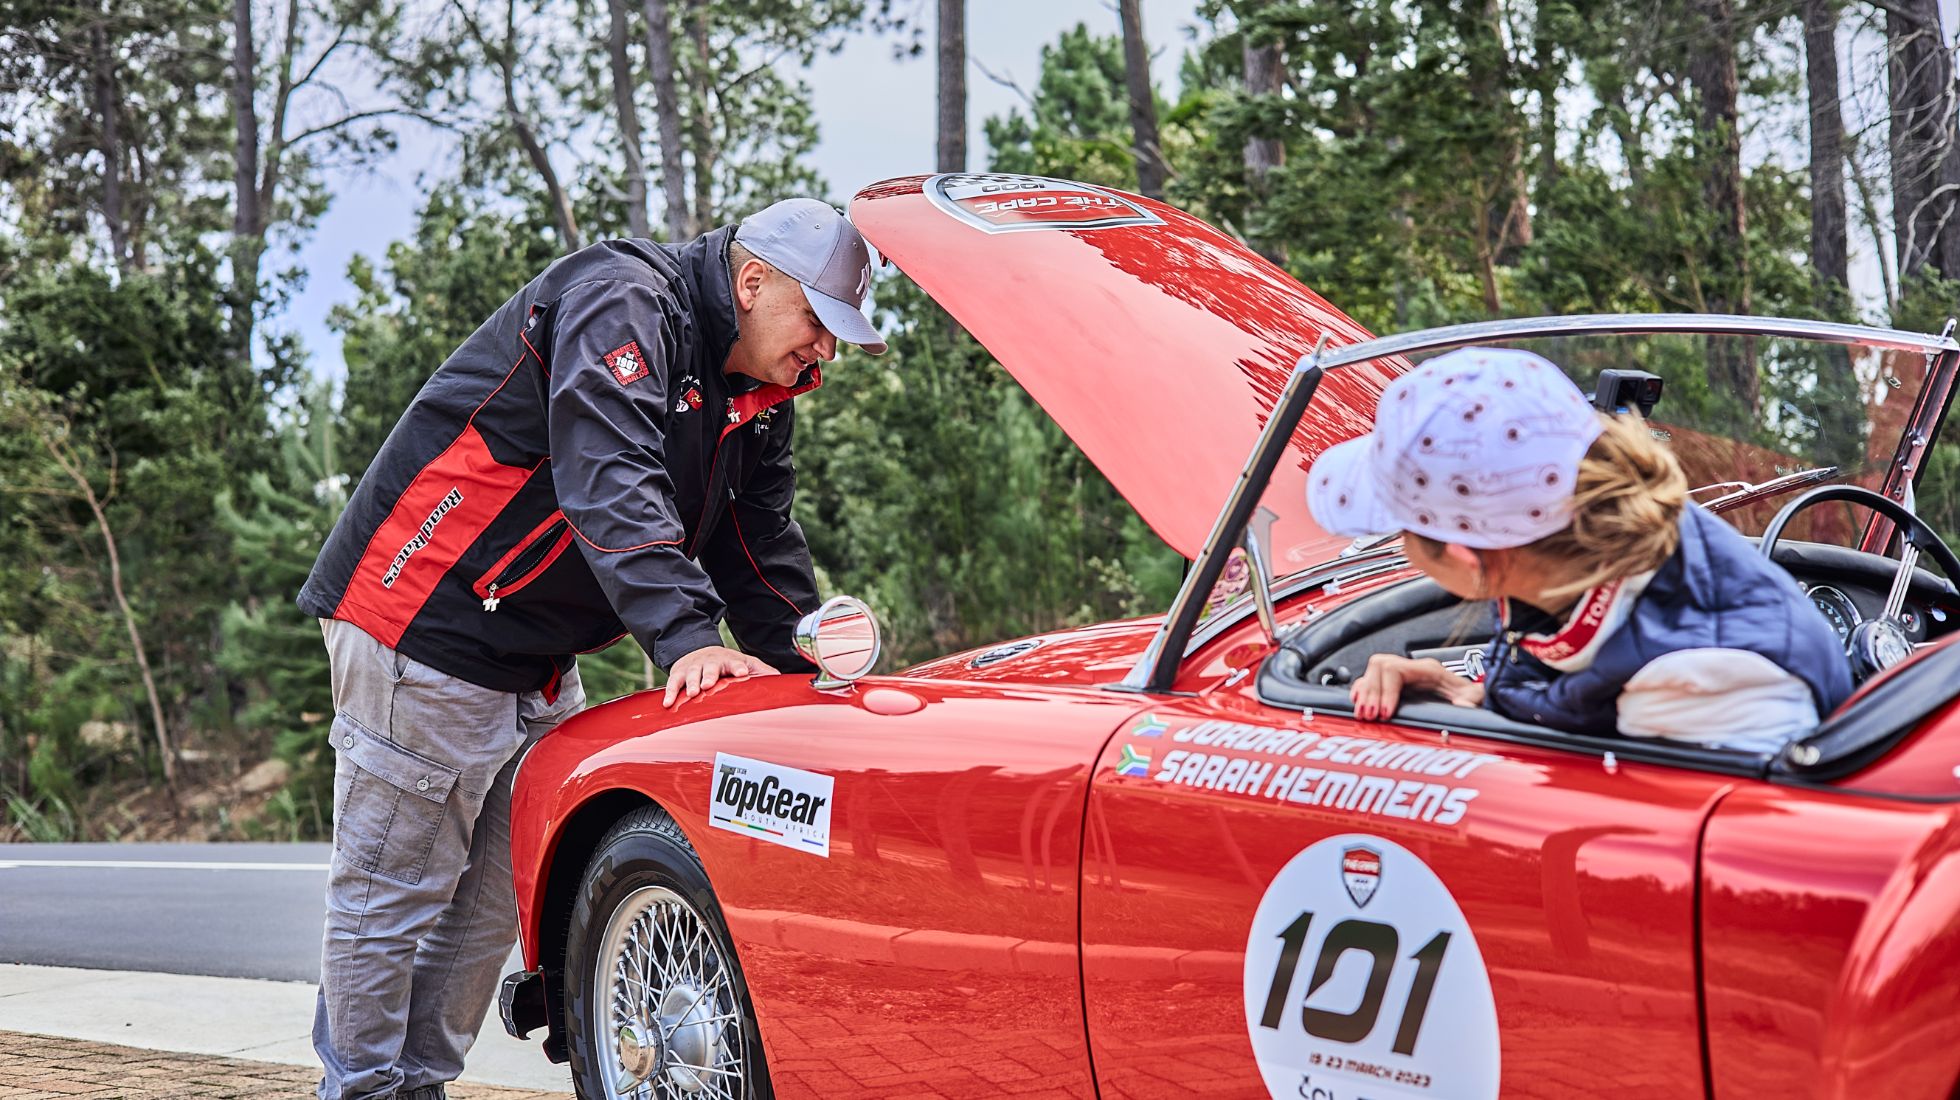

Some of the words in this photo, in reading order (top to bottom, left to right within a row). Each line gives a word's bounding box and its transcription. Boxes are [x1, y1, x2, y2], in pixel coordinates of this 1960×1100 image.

[974, 197, 1058, 214] CAPE
[1060, 196, 1121, 206] THE
[419, 486, 464, 538] Road
[381, 532, 428, 589] Races
[1173, 719, 1321, 757] JORDAN
[1304, 734, 1504, 779] SCHMIDT
[715, 764, 826, 826] TopGear
[1153, 750, 1274, 796] SARAH
[1264, 763, 1480, 825] HEMMENS
[744, 813, 777, 827] SOUTH
[785, 823, 825, 839] AFRICA
[1260, 910, 1453, 1057] 101
